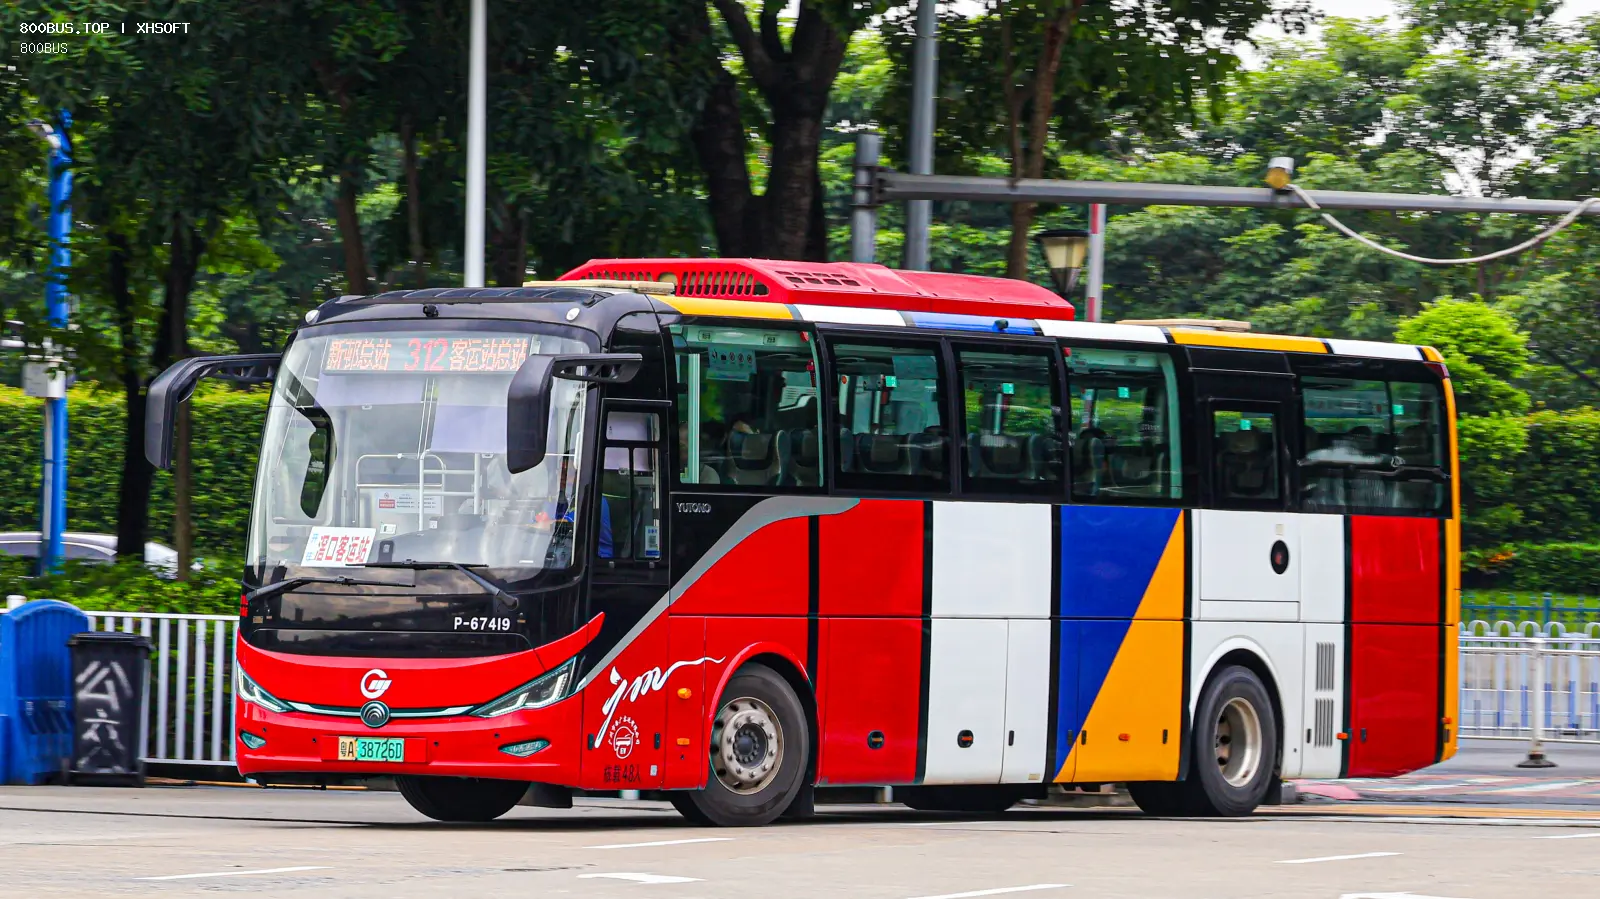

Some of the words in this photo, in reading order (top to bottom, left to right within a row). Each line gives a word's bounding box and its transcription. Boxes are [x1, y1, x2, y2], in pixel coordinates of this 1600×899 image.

[404, 338, 447, 371] 312
[449, 338, 528, 371] 客运站总站
[314, 535, 371, 563] 滘口客运站
[453, 616, 511, 632] P-67419
[360, 742, 402, 759] 38726D
